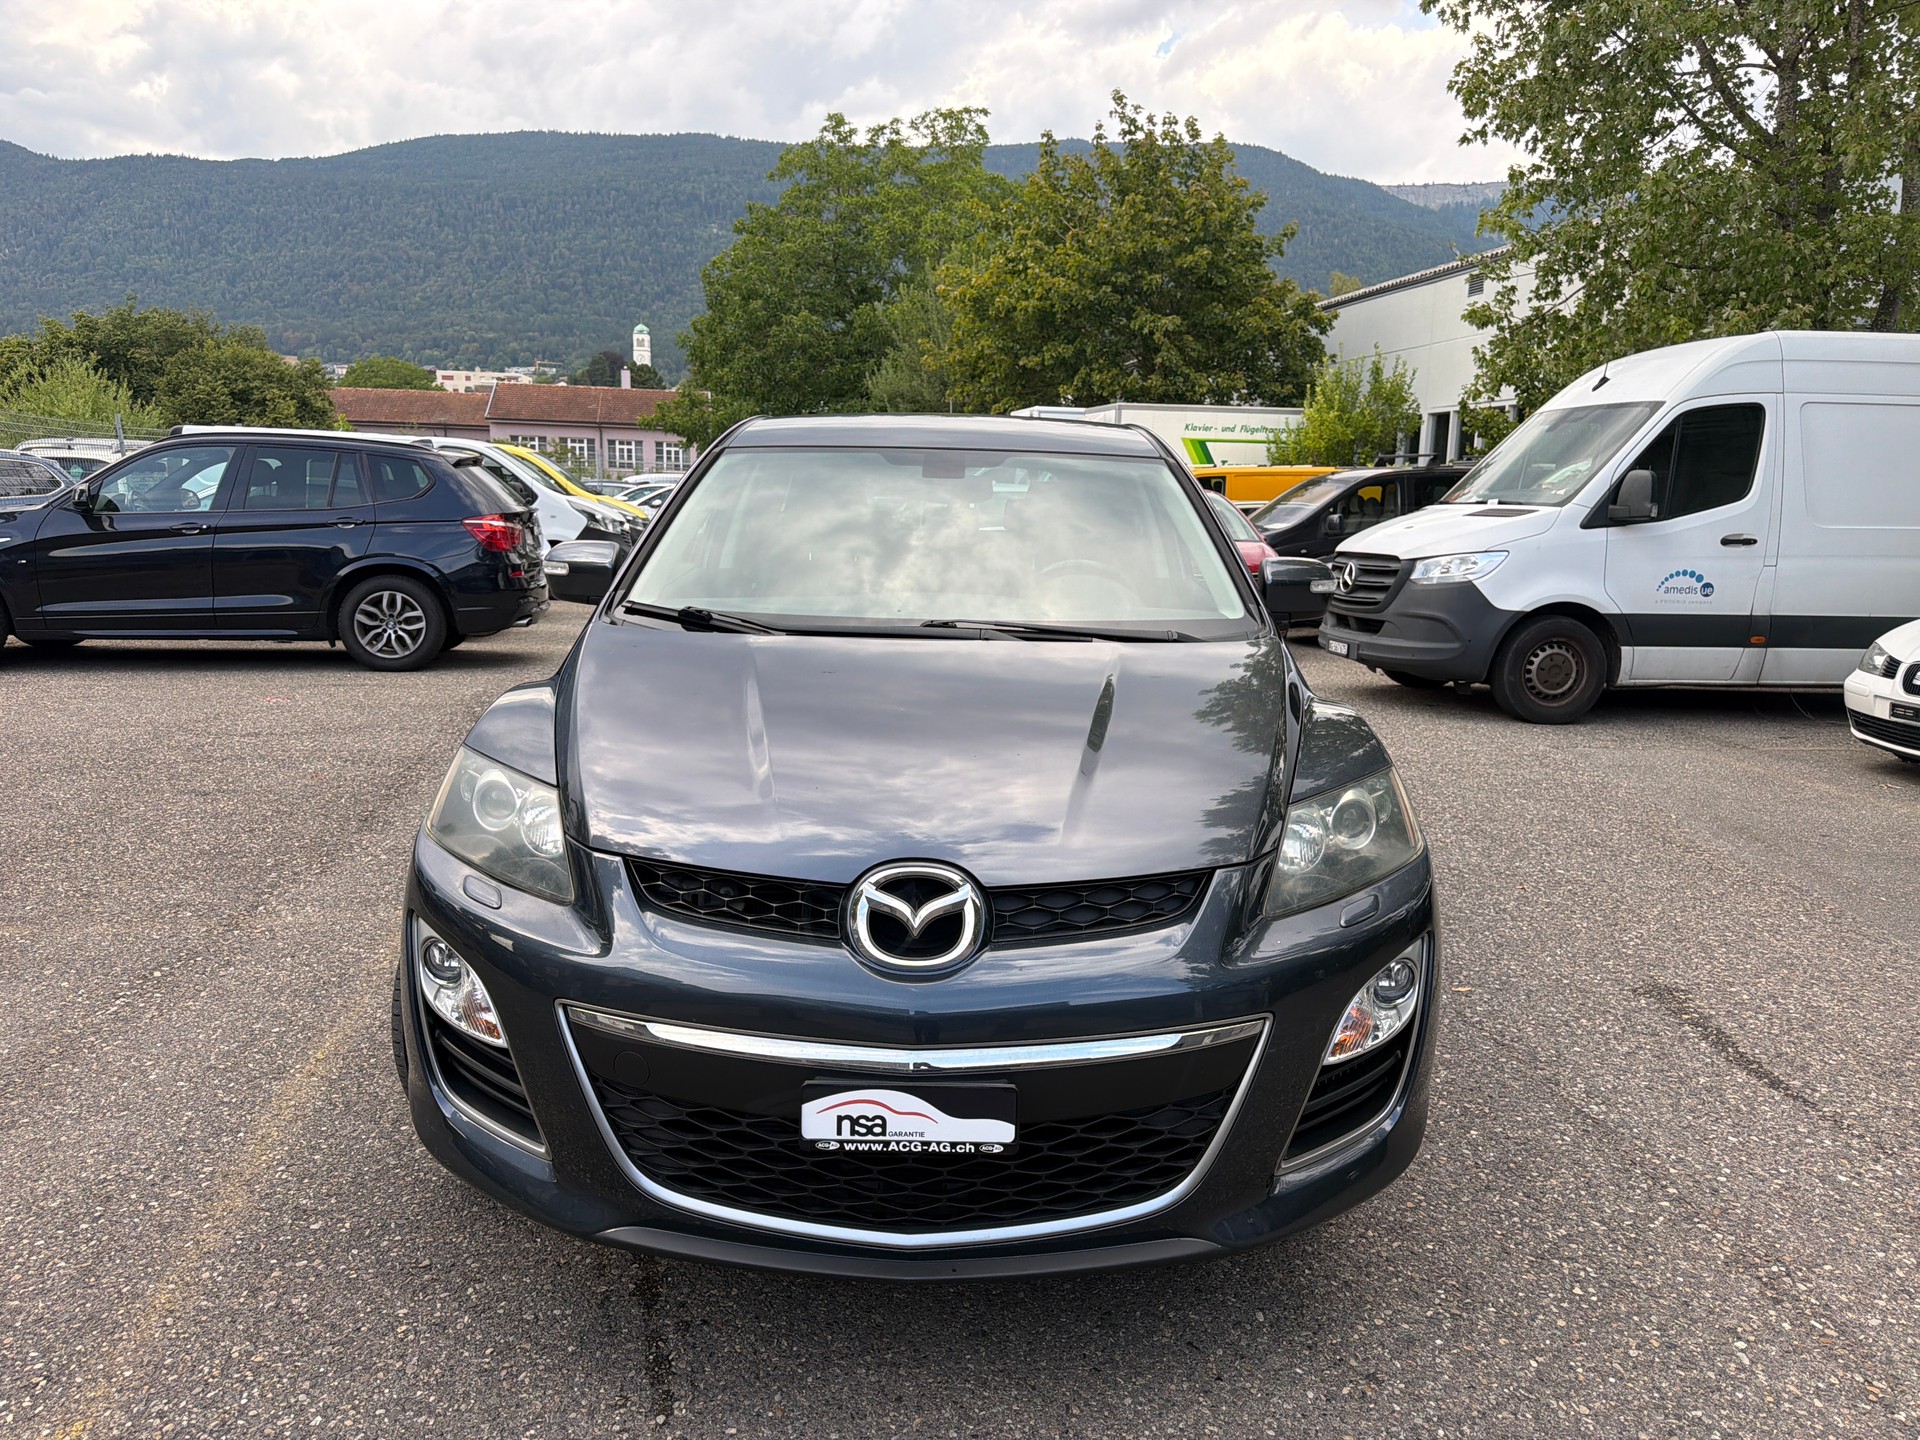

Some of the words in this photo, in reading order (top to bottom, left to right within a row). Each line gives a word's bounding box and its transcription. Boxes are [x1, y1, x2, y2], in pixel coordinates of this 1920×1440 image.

[1221, 424, 1237, 433] und
[1663, 585, 1698, 595] amedis
[836, 1114, 887, 1137] nsa
[888, 1130, 926, 1138] GARANTIE
[843, 1142, 975, 1153] www.ACG-AG.ch
